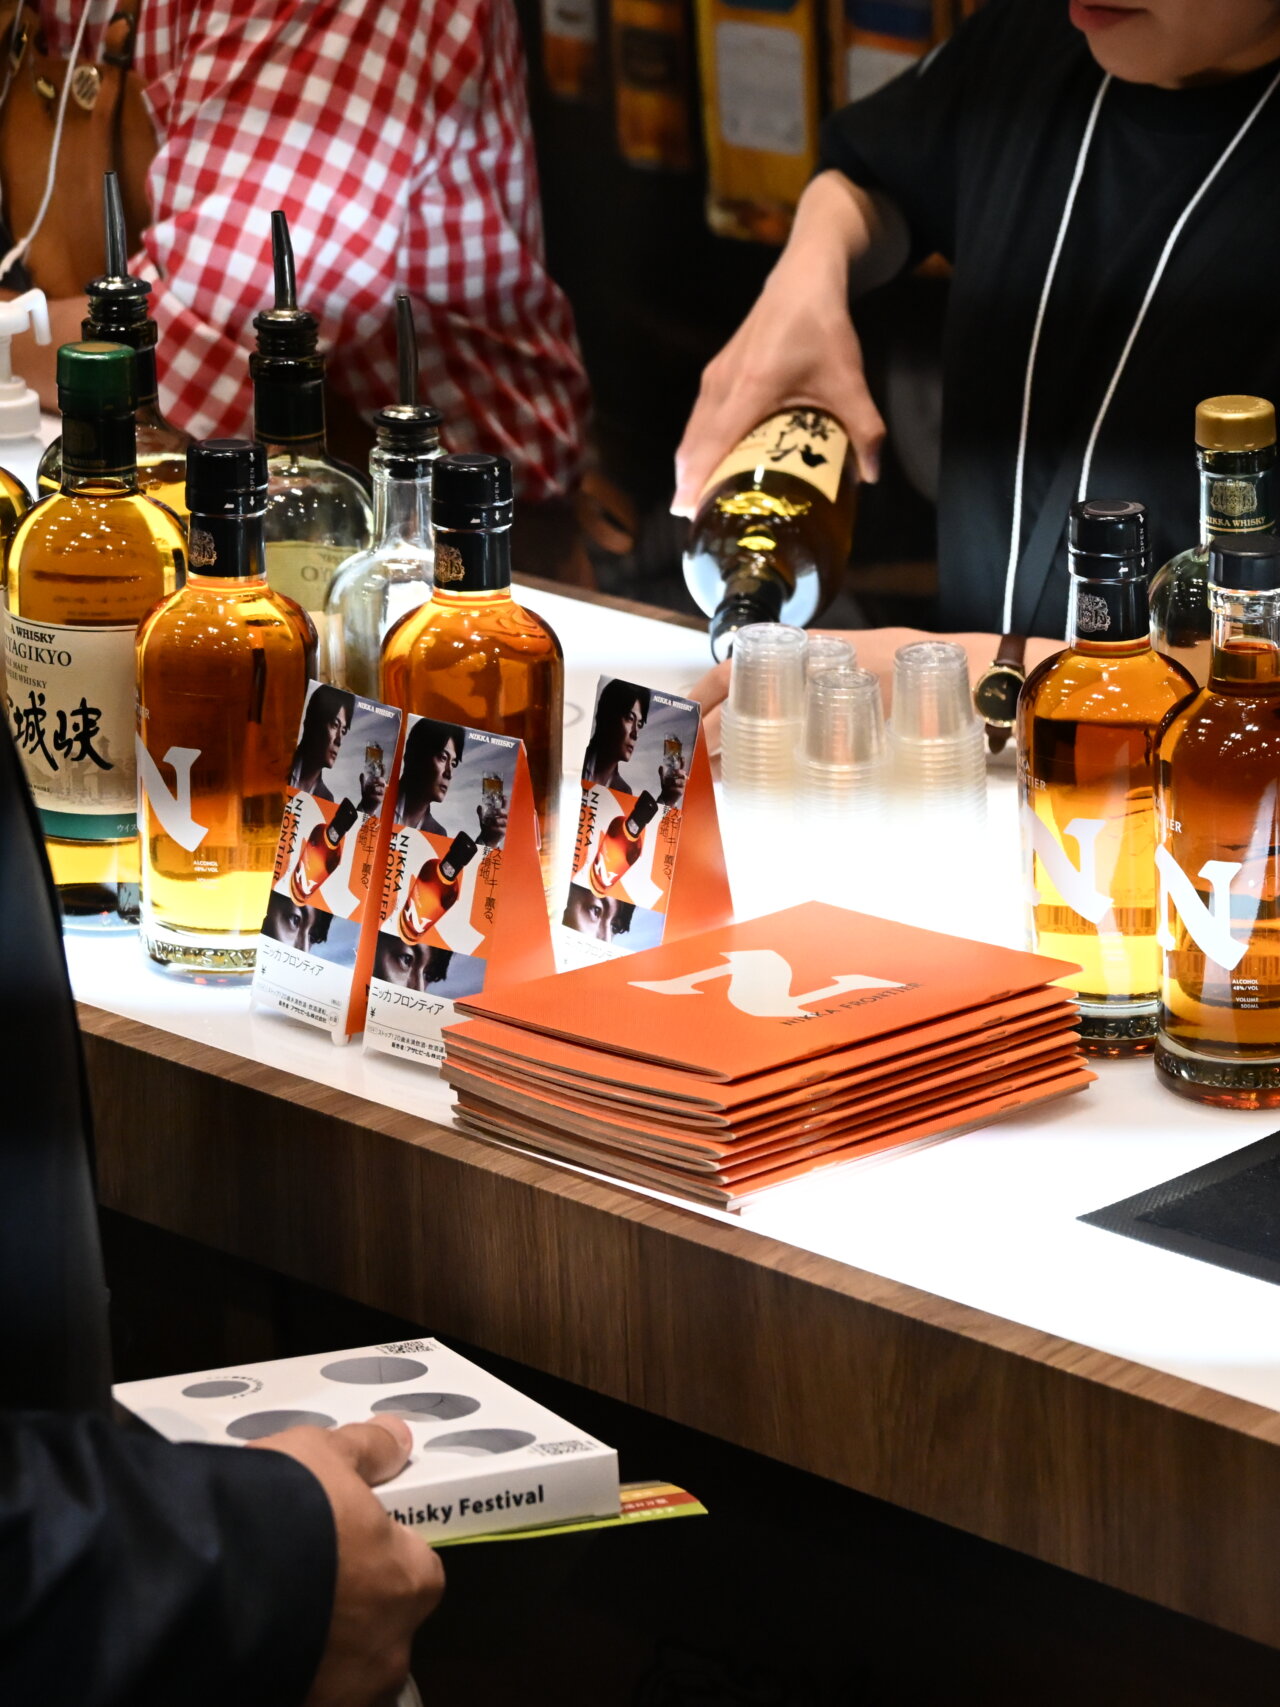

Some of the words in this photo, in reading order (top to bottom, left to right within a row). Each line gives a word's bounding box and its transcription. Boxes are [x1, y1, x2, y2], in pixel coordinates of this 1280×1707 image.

[1232, 516, 1266, 527] WHISKY
[5, 635, 72, 667] IYAGIKYO
[16, 626, 55, 644] WHISKY
[19, 674, 47, 690] WHISKY
[653, 695, 672, 706] NIKKA
[357, 702, 375, 713] NIKKA
[8, 690, 114, 771] 城峡
[468, 732, 490, 744] NIKKA
[490, 738, 516, 749] WHISKY
[272, 795, 294, 881] FRONTIER
[286, 798, 304, 854] NIKKA
[571, 787, 589, 873] FRONTIER
[583, 791, 600, 847] NIKKA
[379, 832, 398, 921] FRONTIER
[392, 834, 410, 892] NIKKA
[1023, 803, 1114, 925] N
[1154, 843, 1249, 971] N
[283, 952, 325, 976] フロンティア
[371, 985, 391, 1002] ニッカ
[393, 992, 445, 1016] フロンティア
[780, 1007, 840, 1026] NIKKA
[839, 981, 925, 1011] FRONTIER
[387, 1501, 453, 1526] hisky
[459, 1484, 545, 1516] Festival
